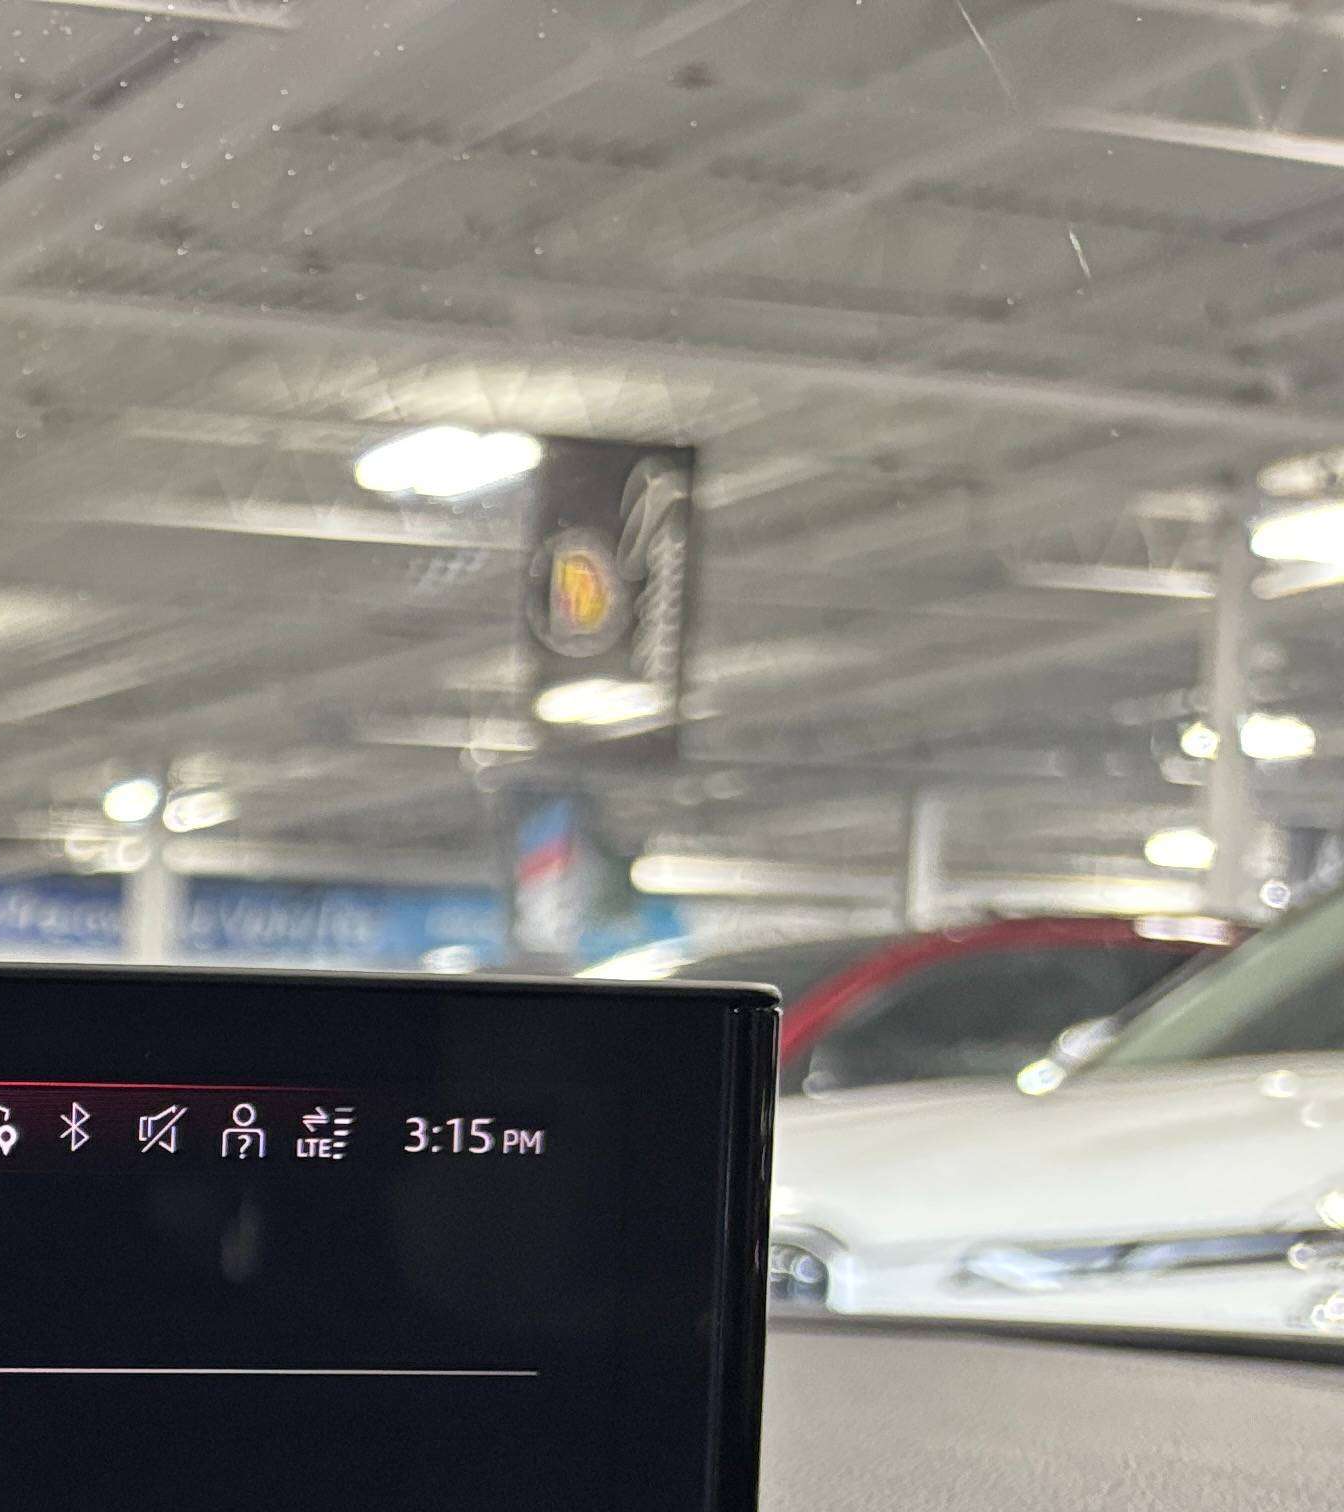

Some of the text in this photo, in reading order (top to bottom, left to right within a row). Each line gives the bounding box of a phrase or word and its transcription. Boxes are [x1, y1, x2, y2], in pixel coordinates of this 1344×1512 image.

[296, 1138, 332, 1158] LTE
[403, 1116, 545, 1155] 3:15 PM
